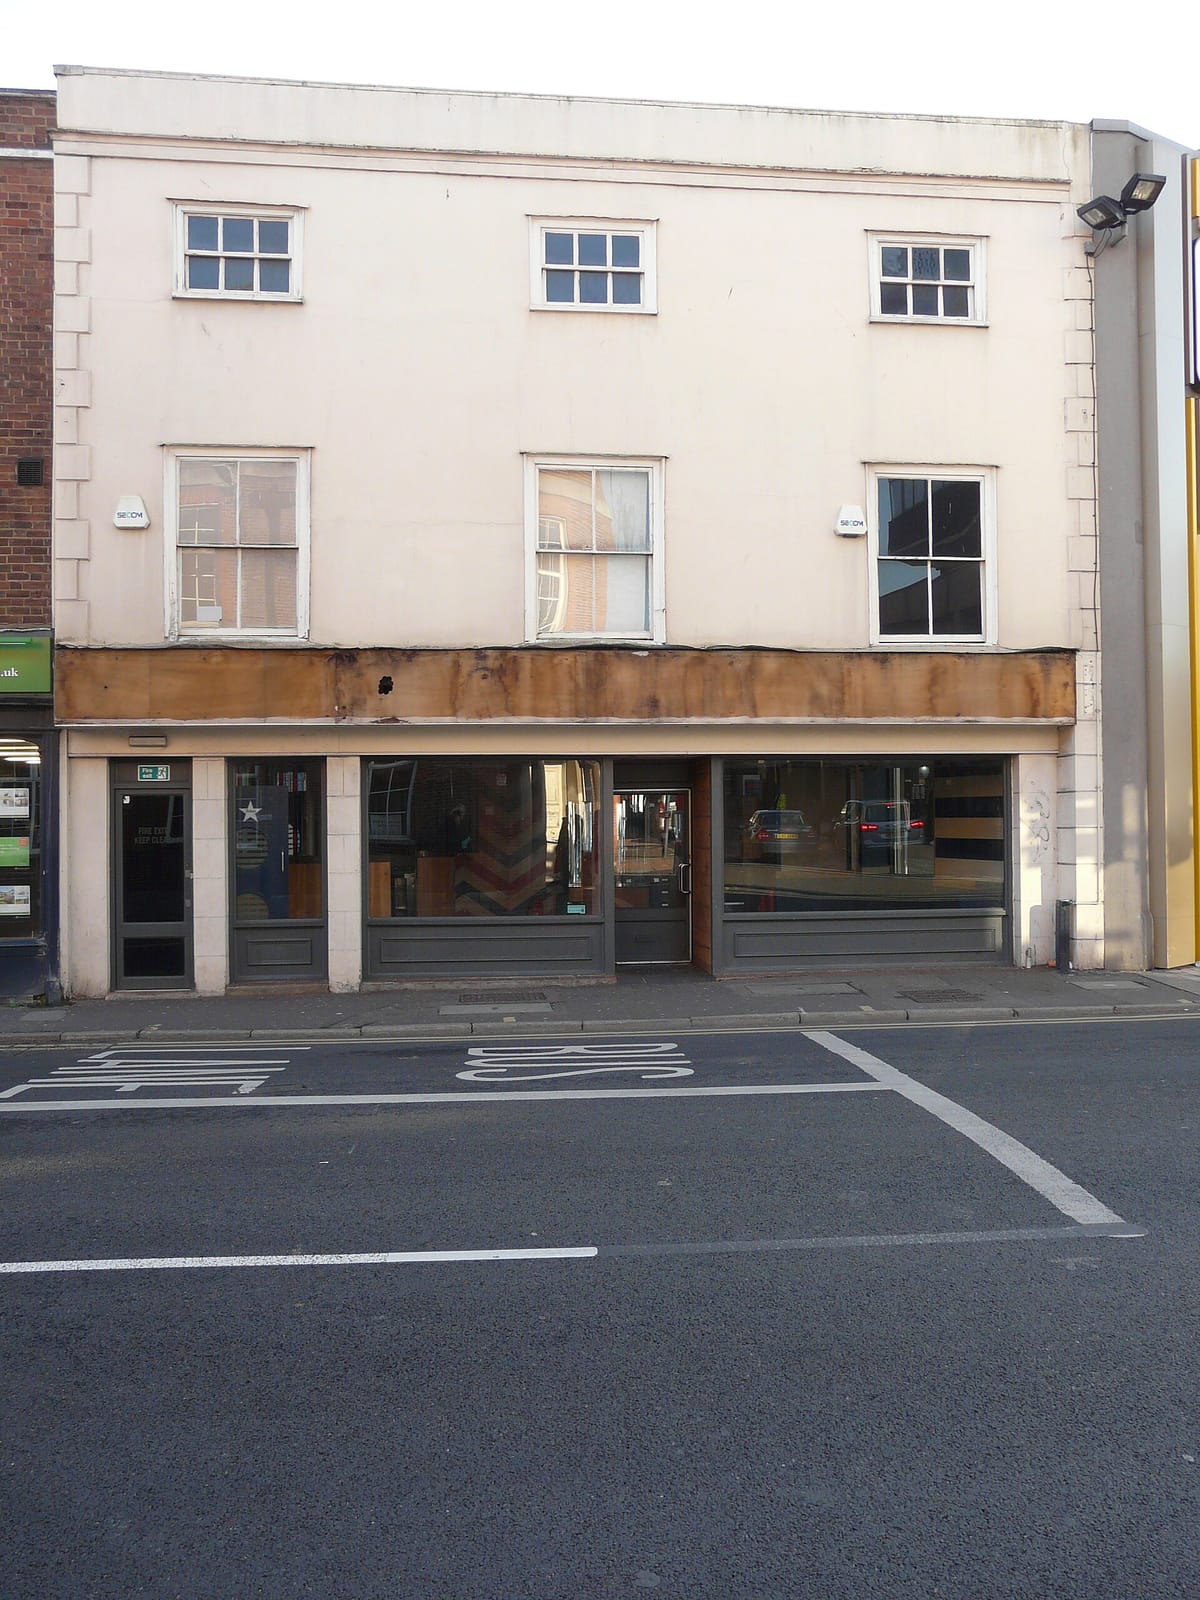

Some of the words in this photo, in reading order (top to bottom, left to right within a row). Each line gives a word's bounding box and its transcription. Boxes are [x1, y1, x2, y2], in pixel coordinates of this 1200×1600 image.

[116, 511, 143, 519] SECOM
[840, 519, 864, 527] SECOM
[455, 1043, 695, 1081] BUS
